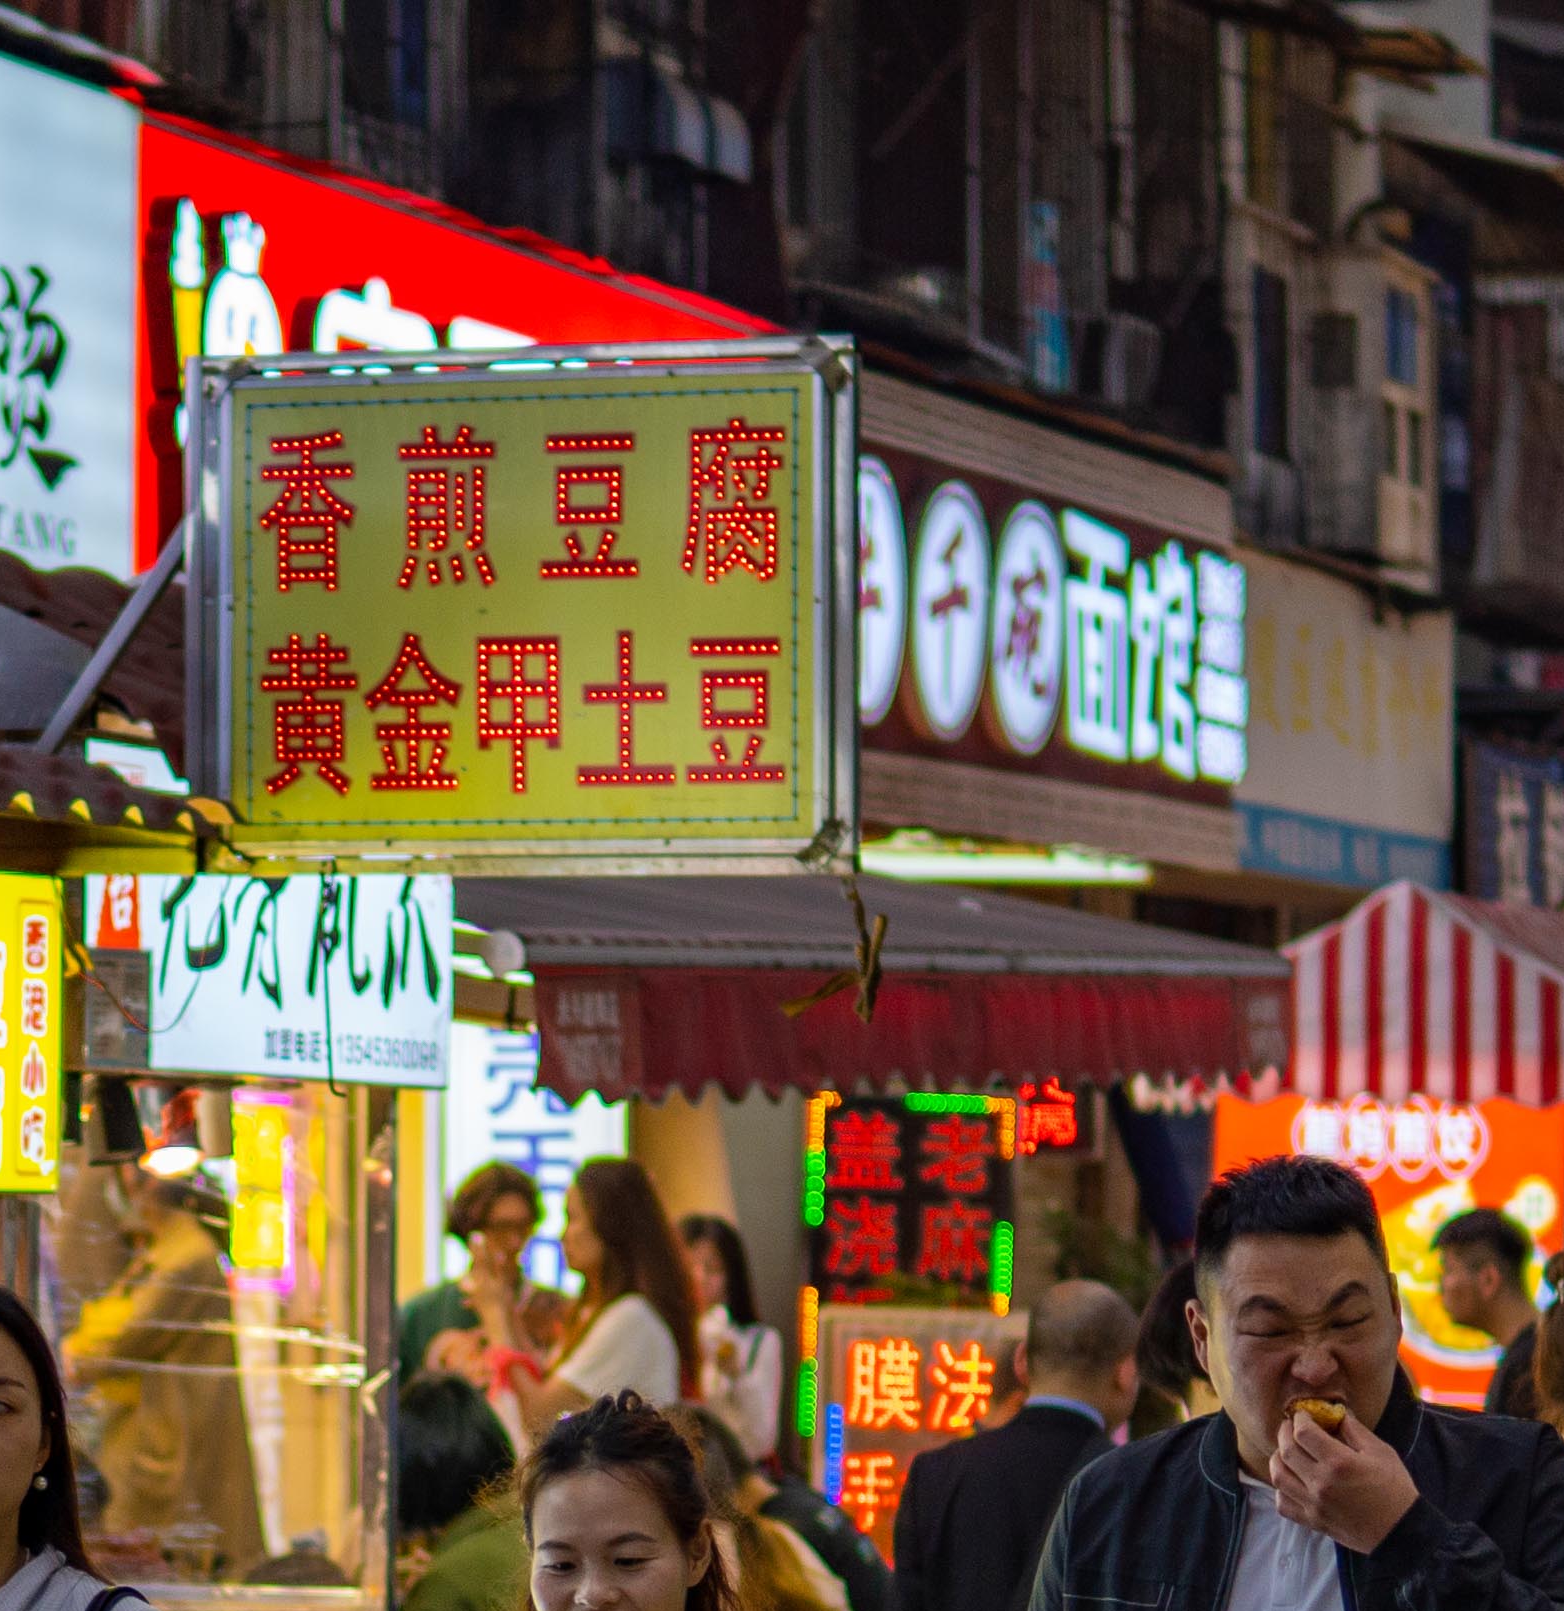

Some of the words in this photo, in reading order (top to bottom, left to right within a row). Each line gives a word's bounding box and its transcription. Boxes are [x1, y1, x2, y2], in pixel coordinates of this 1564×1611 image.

[260, 419, 786, 592] 香煎豆腐
[261, 631, 786, 796] 黄金甲土豆
